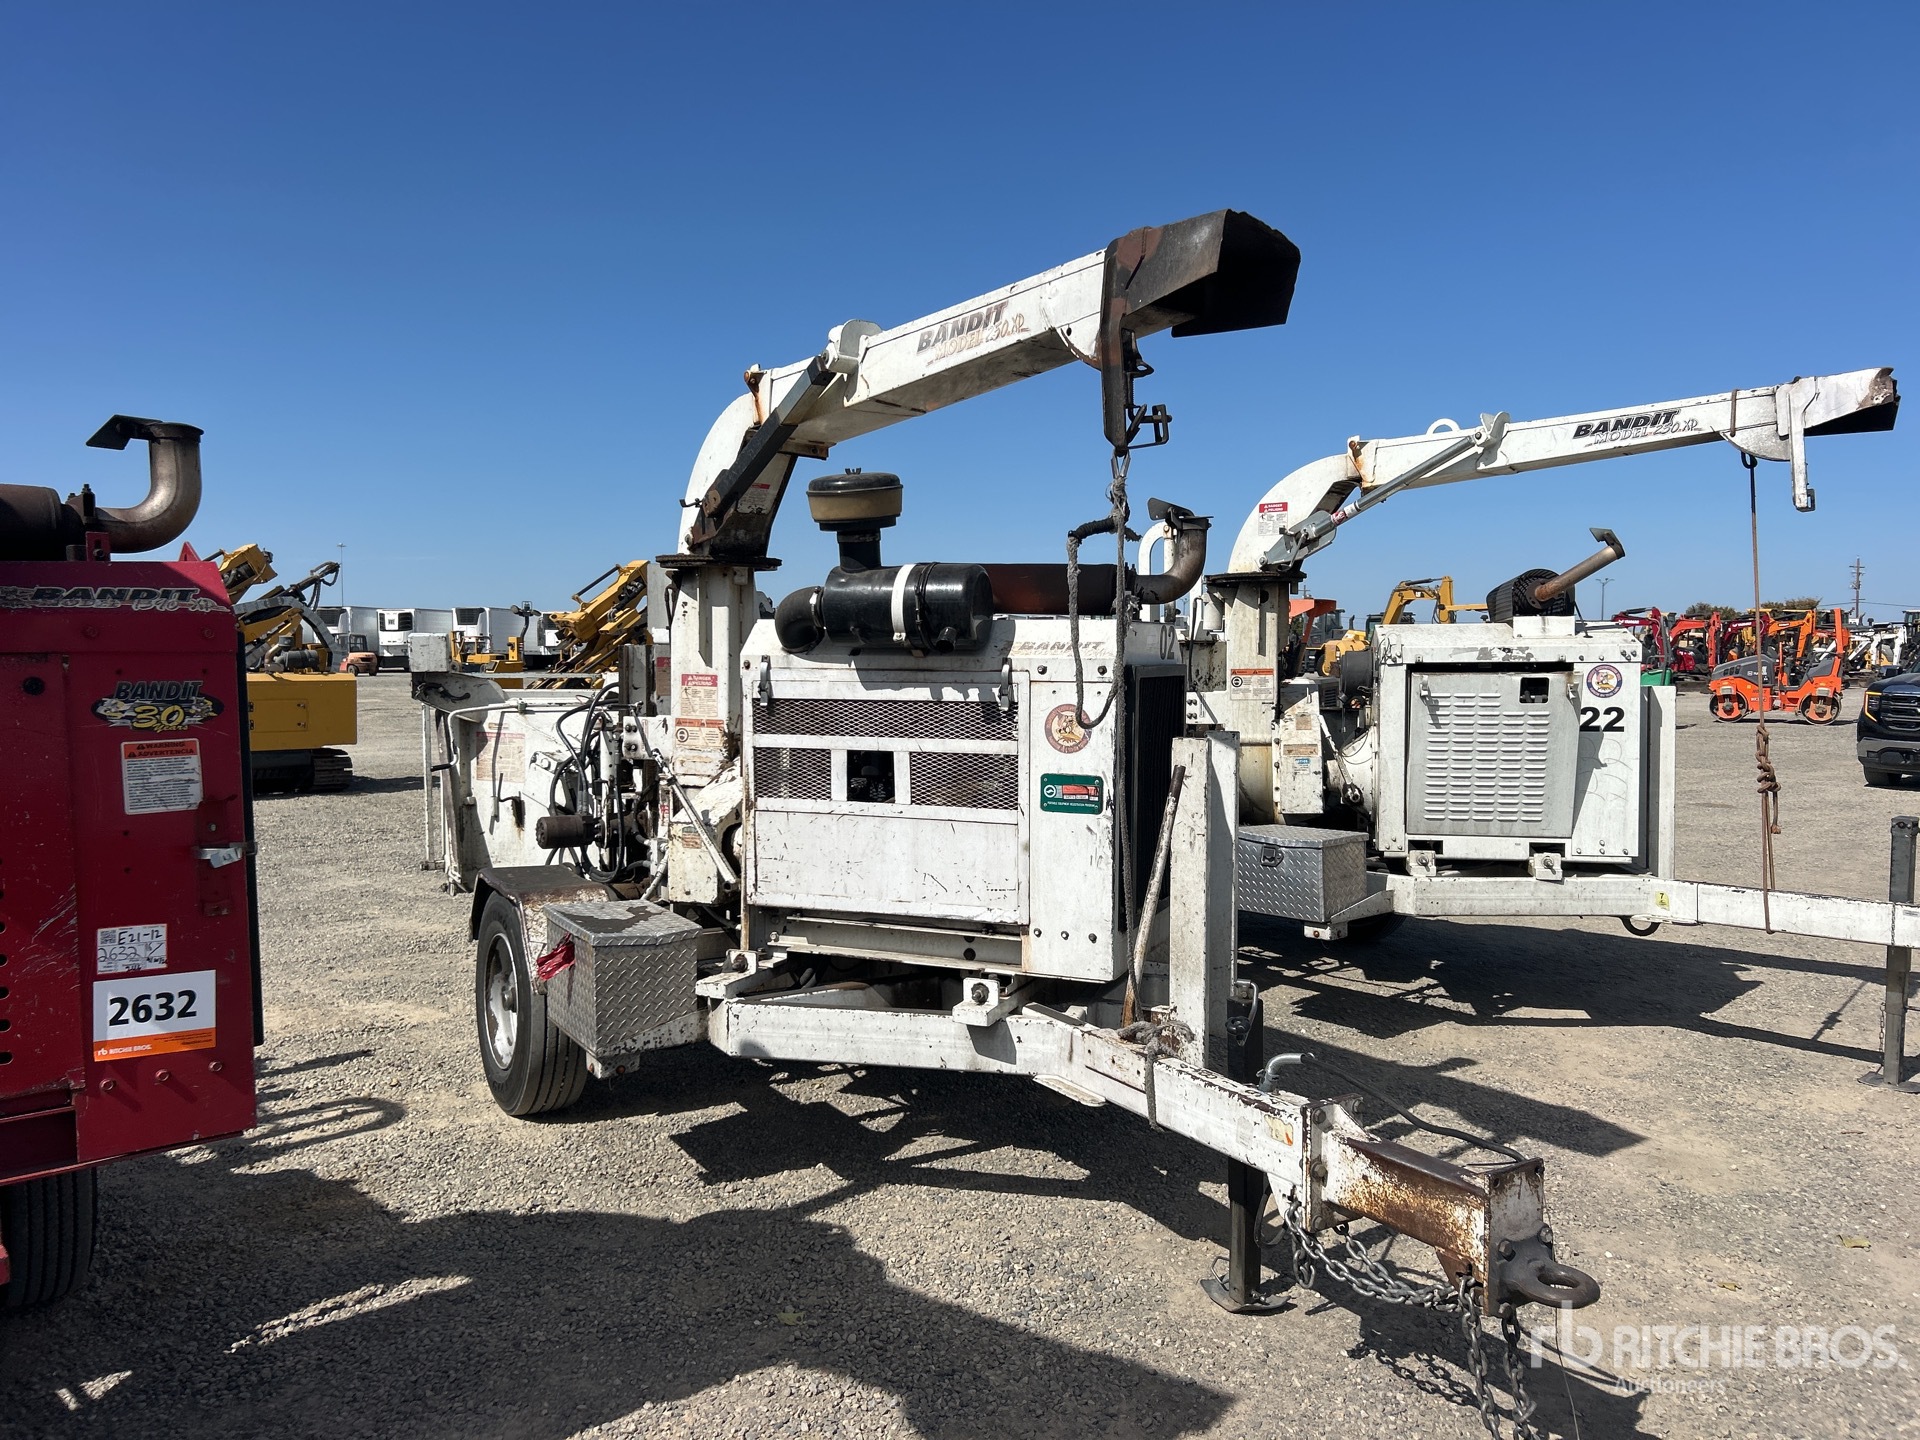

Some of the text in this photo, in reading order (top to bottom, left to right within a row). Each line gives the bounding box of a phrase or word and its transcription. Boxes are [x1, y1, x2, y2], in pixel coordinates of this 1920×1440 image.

[917, 300, 1009, 354] BANDIT
[935, 329, 984, 360] MODEL
[1573, 408, 1681, 439] BANDIT
[1594, 428, 1648, 444] MODEL
[31, 587, 200, 602] BANDIT
[1160, 625, 1175, 660] 02
[114, 681, 203, 701] BANDIT
[132, 705, 185, 729] 30
[1580, 706, 1625, 732] 22
[98, 946, 141, 962] 2632
[109, 990, 197, 1026] 2632
